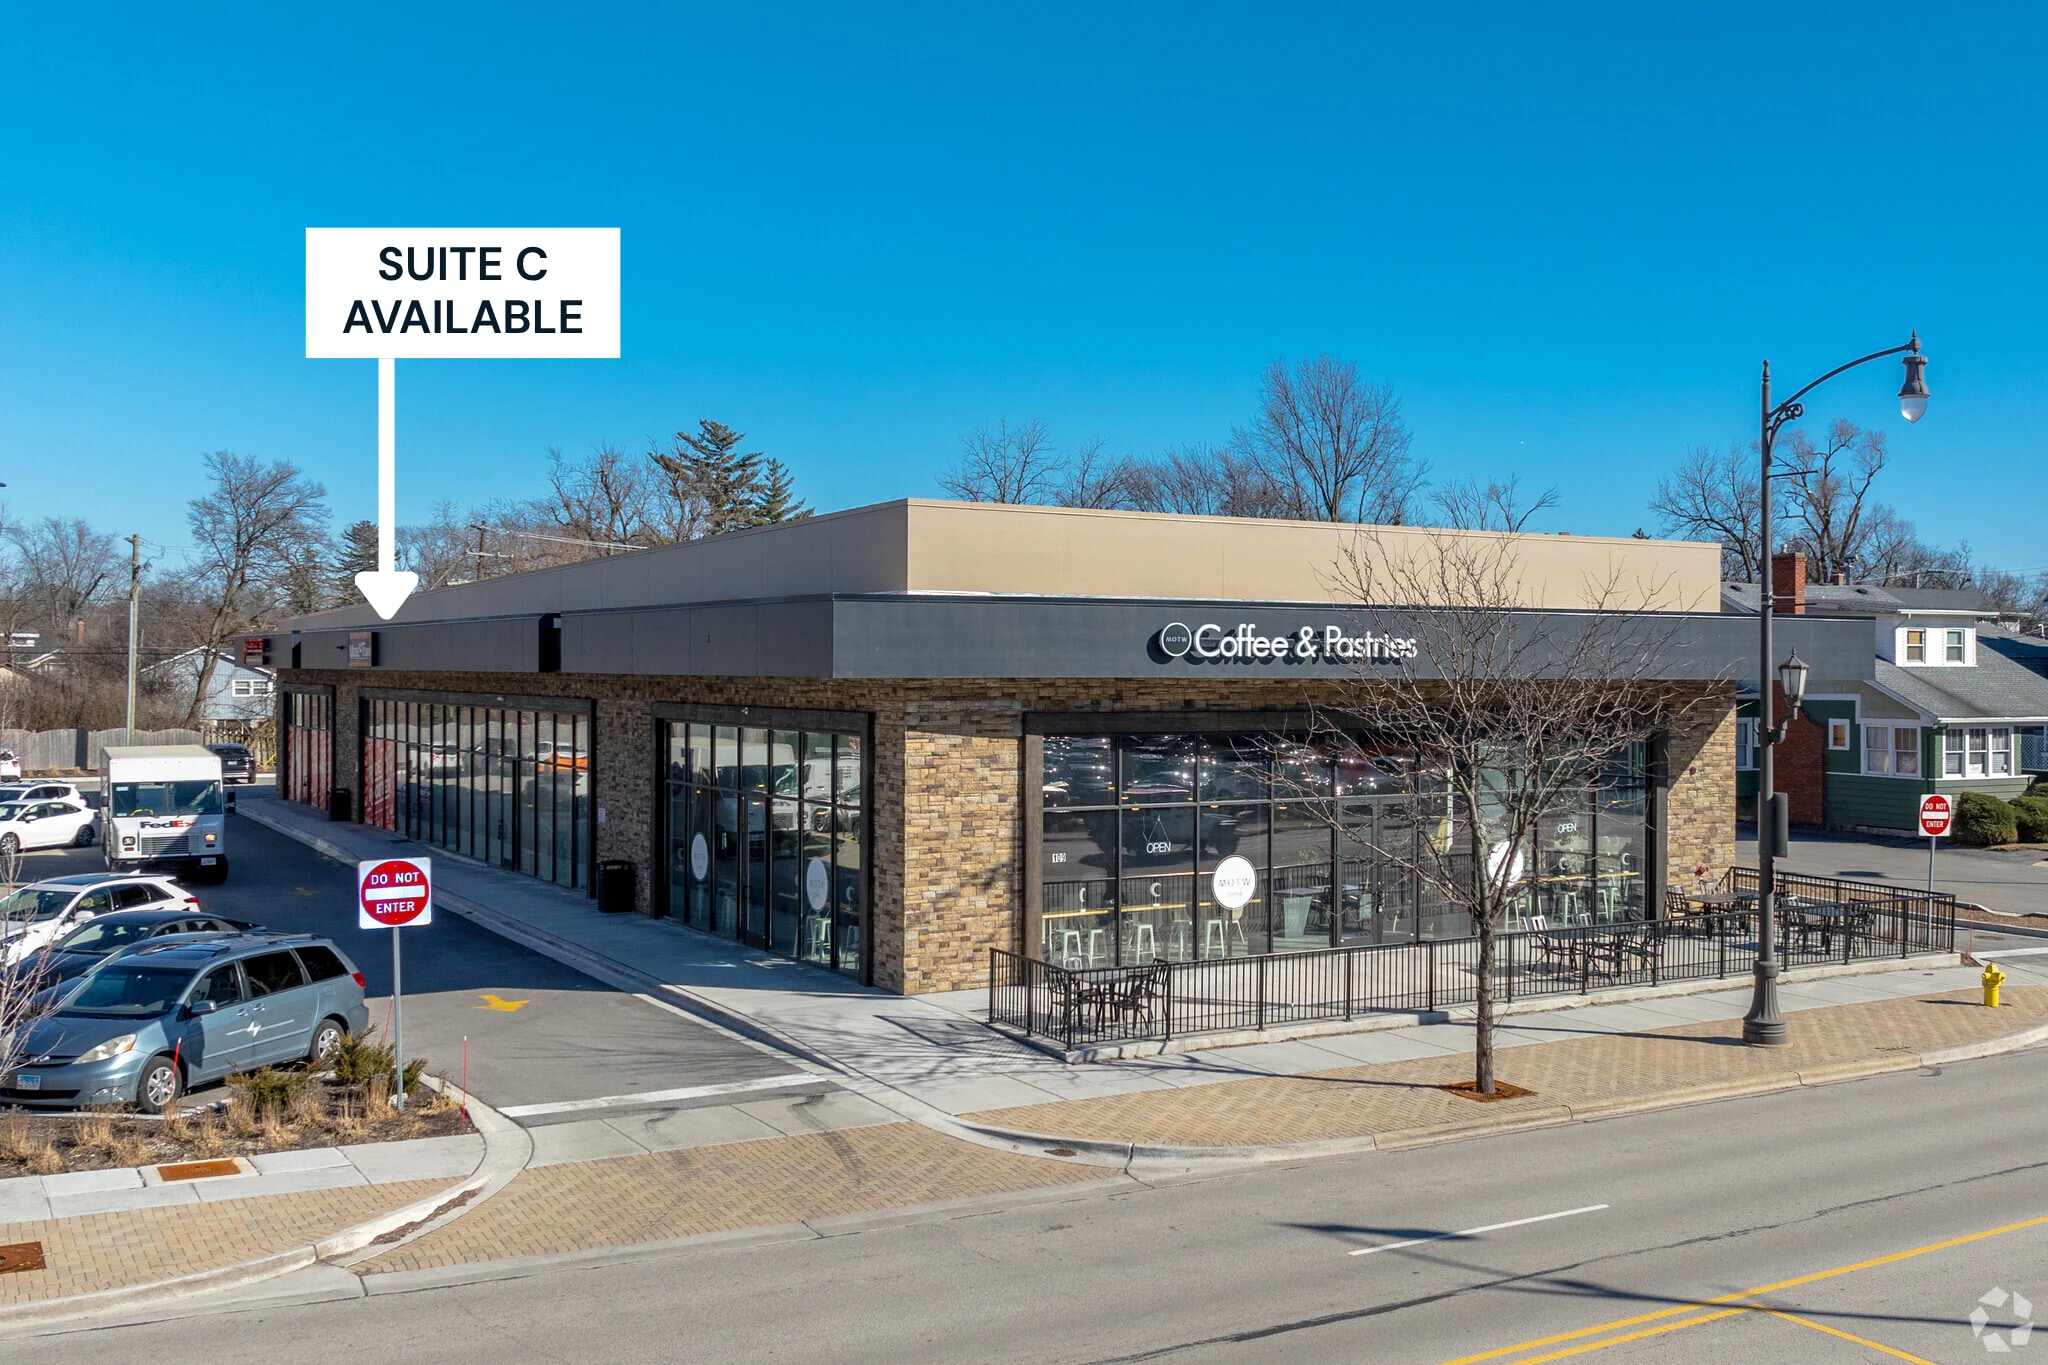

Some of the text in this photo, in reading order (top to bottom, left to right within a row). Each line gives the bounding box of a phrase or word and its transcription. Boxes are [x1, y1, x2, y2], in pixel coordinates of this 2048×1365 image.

[1195, 623, 1418, 658] Coffee & Pastries
[140, 820, 196, 829] FedEx
[1557, 823, 1577, 834] OPEN
[1146, 841, 1172, 854] OPEN
[371, 872, 420, 885] DO NOT
[1218, 877, 1251, 887] MOTW
[376, 901, 415, 914] ENTER
